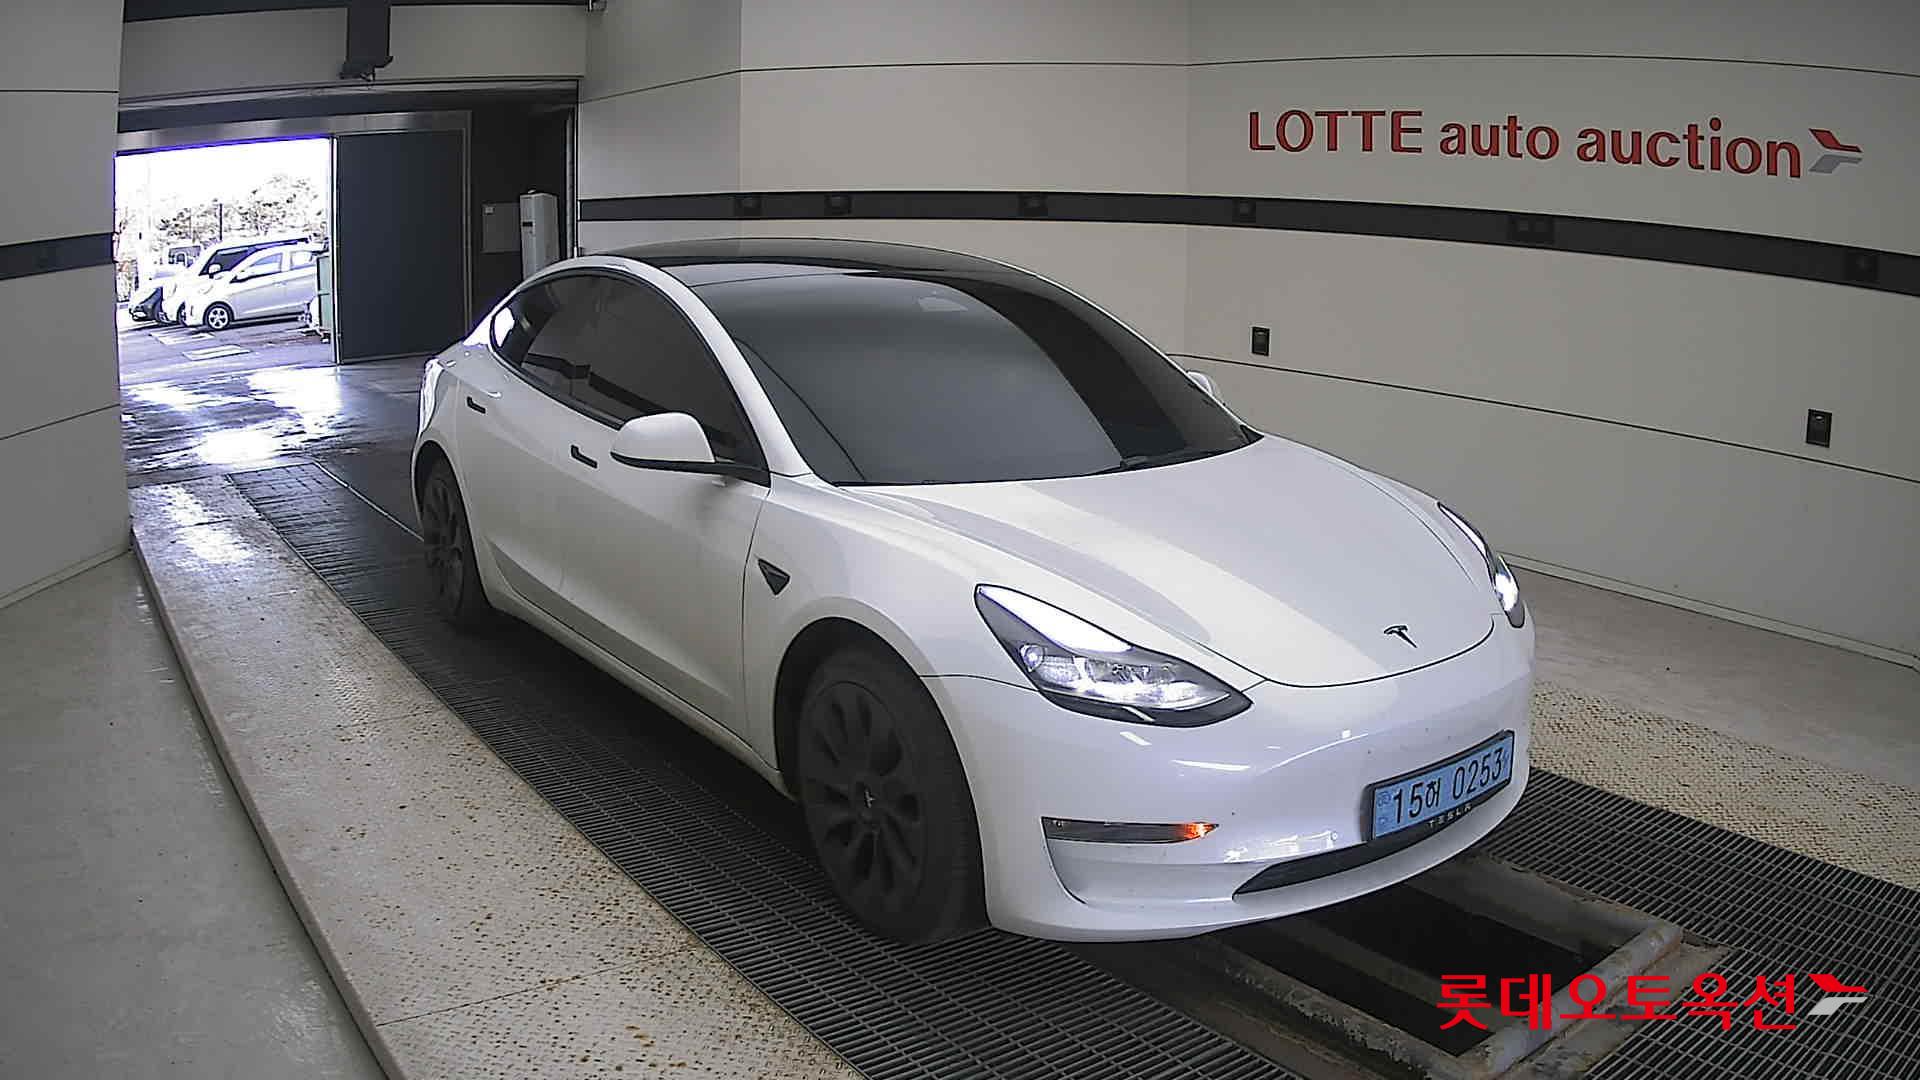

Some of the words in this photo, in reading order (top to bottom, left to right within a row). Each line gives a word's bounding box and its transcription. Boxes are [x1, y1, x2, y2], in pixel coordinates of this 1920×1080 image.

[1248, 109, 1423, 154] LOTTE
[1439, 115, 1560, 160] auto
[1576, 116, 1801, 178] auction
[1393, 777, 1441, 824] 15허
[1452, 747, 1504, 800] 0253
[1428, 804, 1472, 828] TESLA
